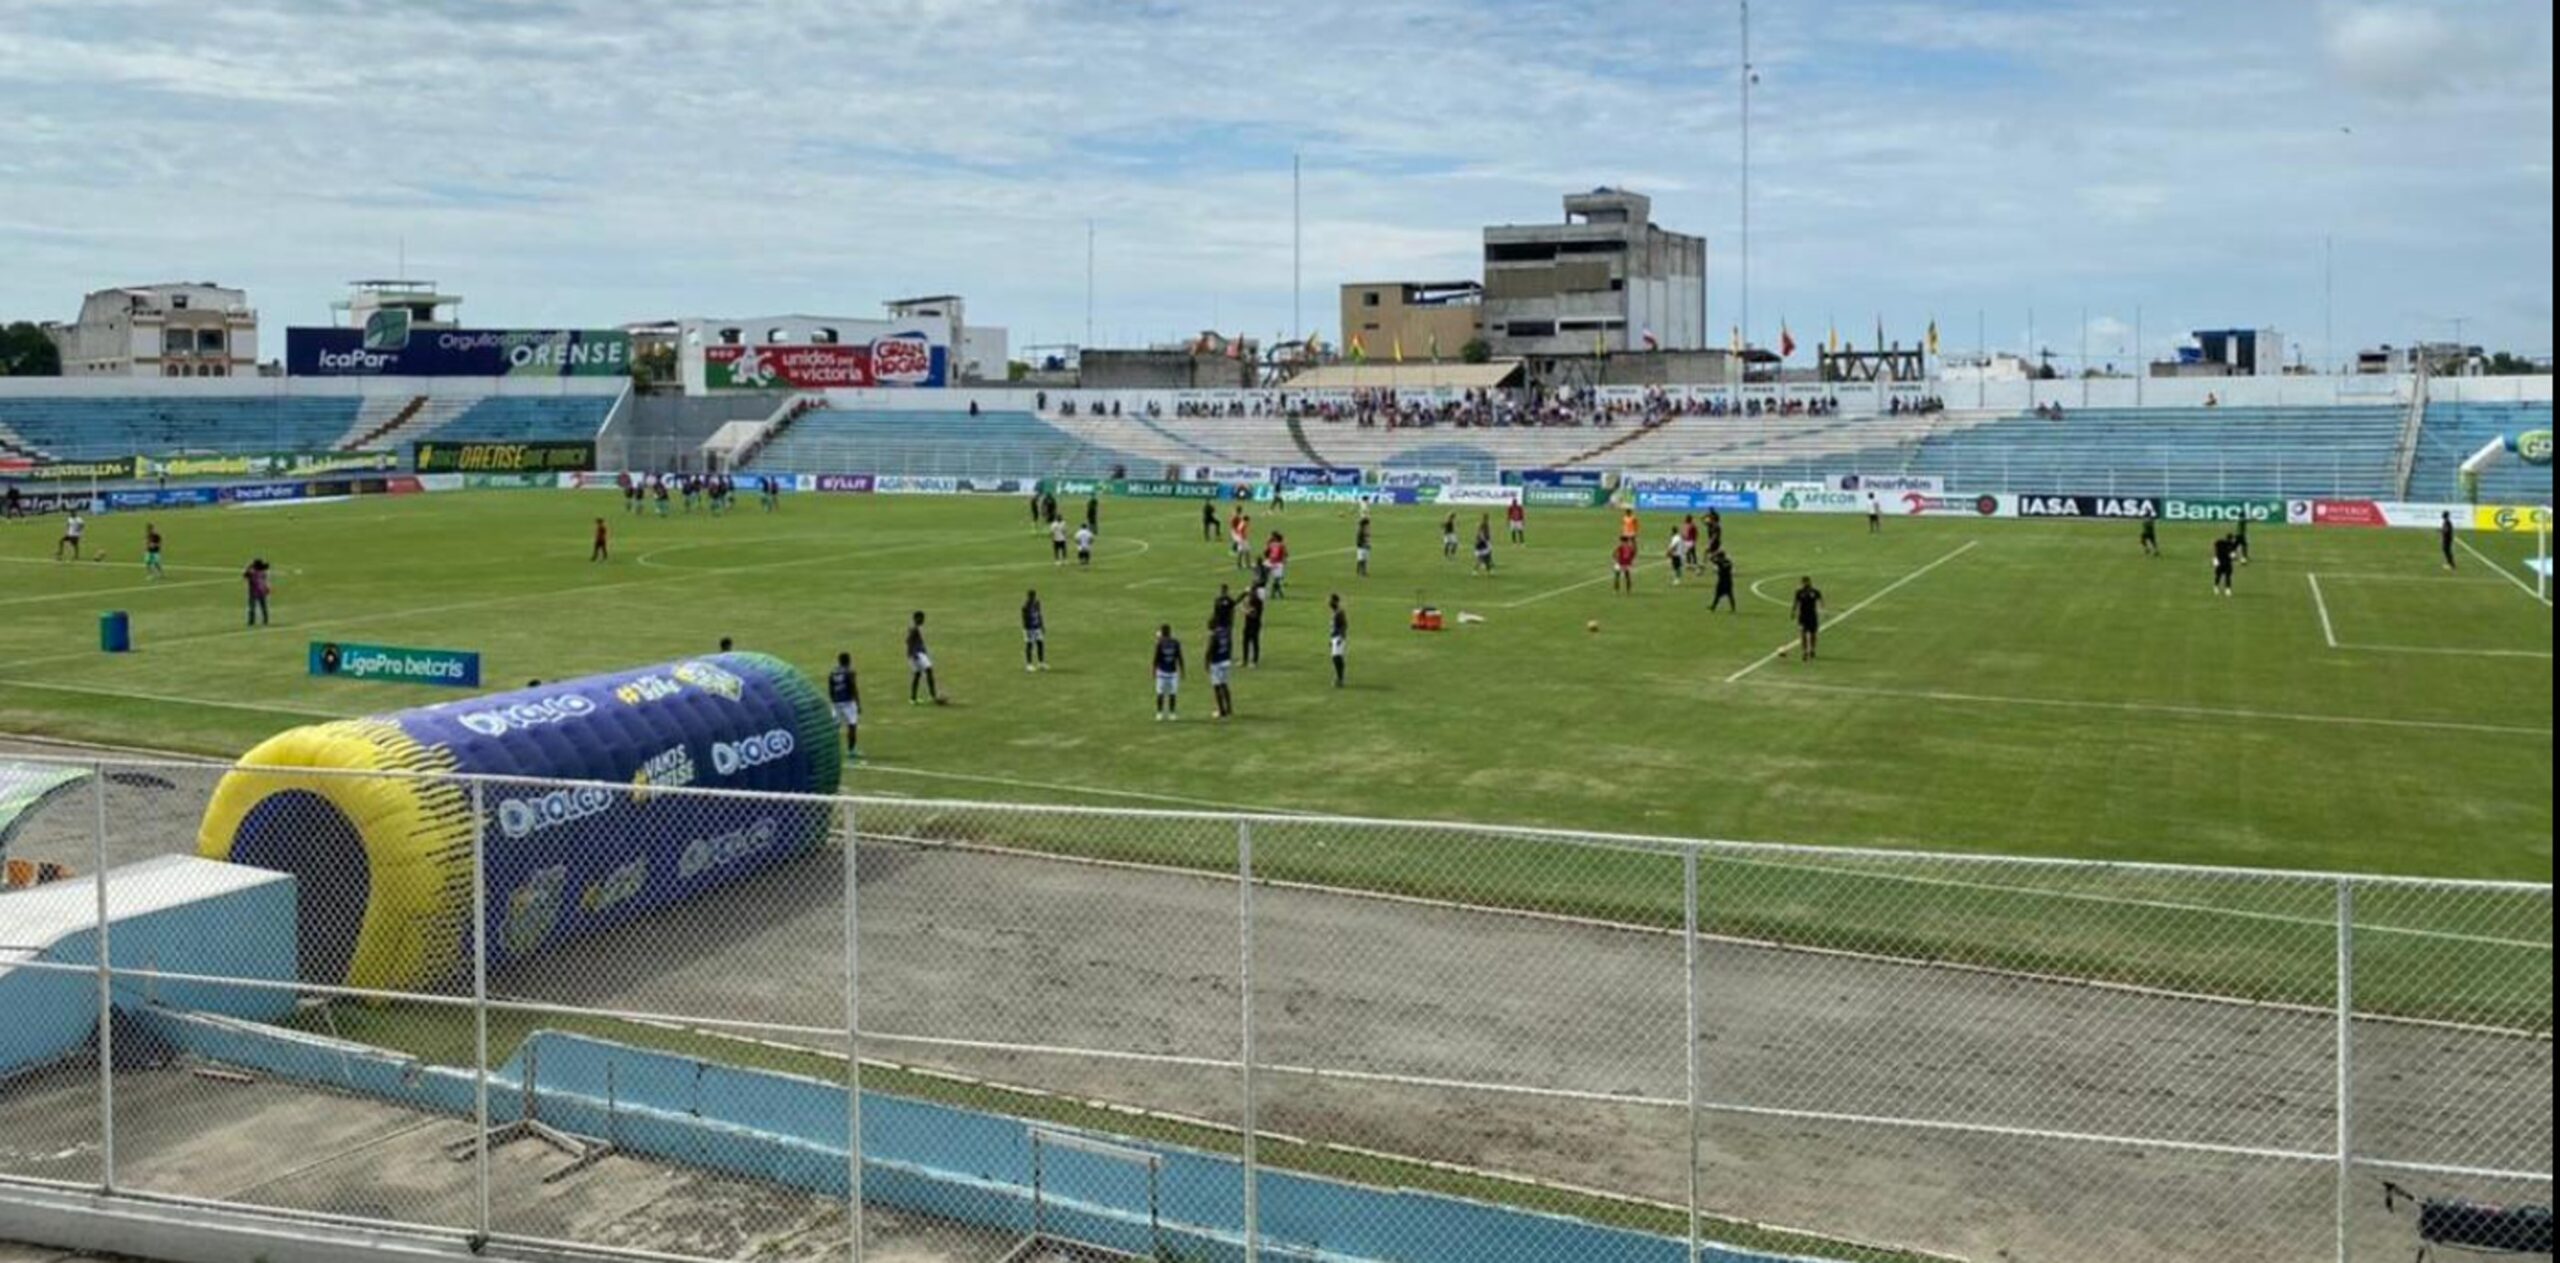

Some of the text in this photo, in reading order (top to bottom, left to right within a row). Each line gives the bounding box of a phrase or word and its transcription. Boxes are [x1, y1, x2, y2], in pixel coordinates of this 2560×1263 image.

[438, 332, 571, 350] Orgullosamente
[876, 341, 926, 358] GRAN
[318, 349, 390, 368] IcaPar
[510, 342, 623, 367] ORENSE
[782, 350, 835, 366] unidos
[802, 366, 863, 381] victoria
[873, 356, 927, 377] HOGAR
[1864, 476, 1932, 490] IncarPalm
[2021, 498, 2157, 517] IASA IASA
[341, 652, 464, 678] LigaPro betcris
